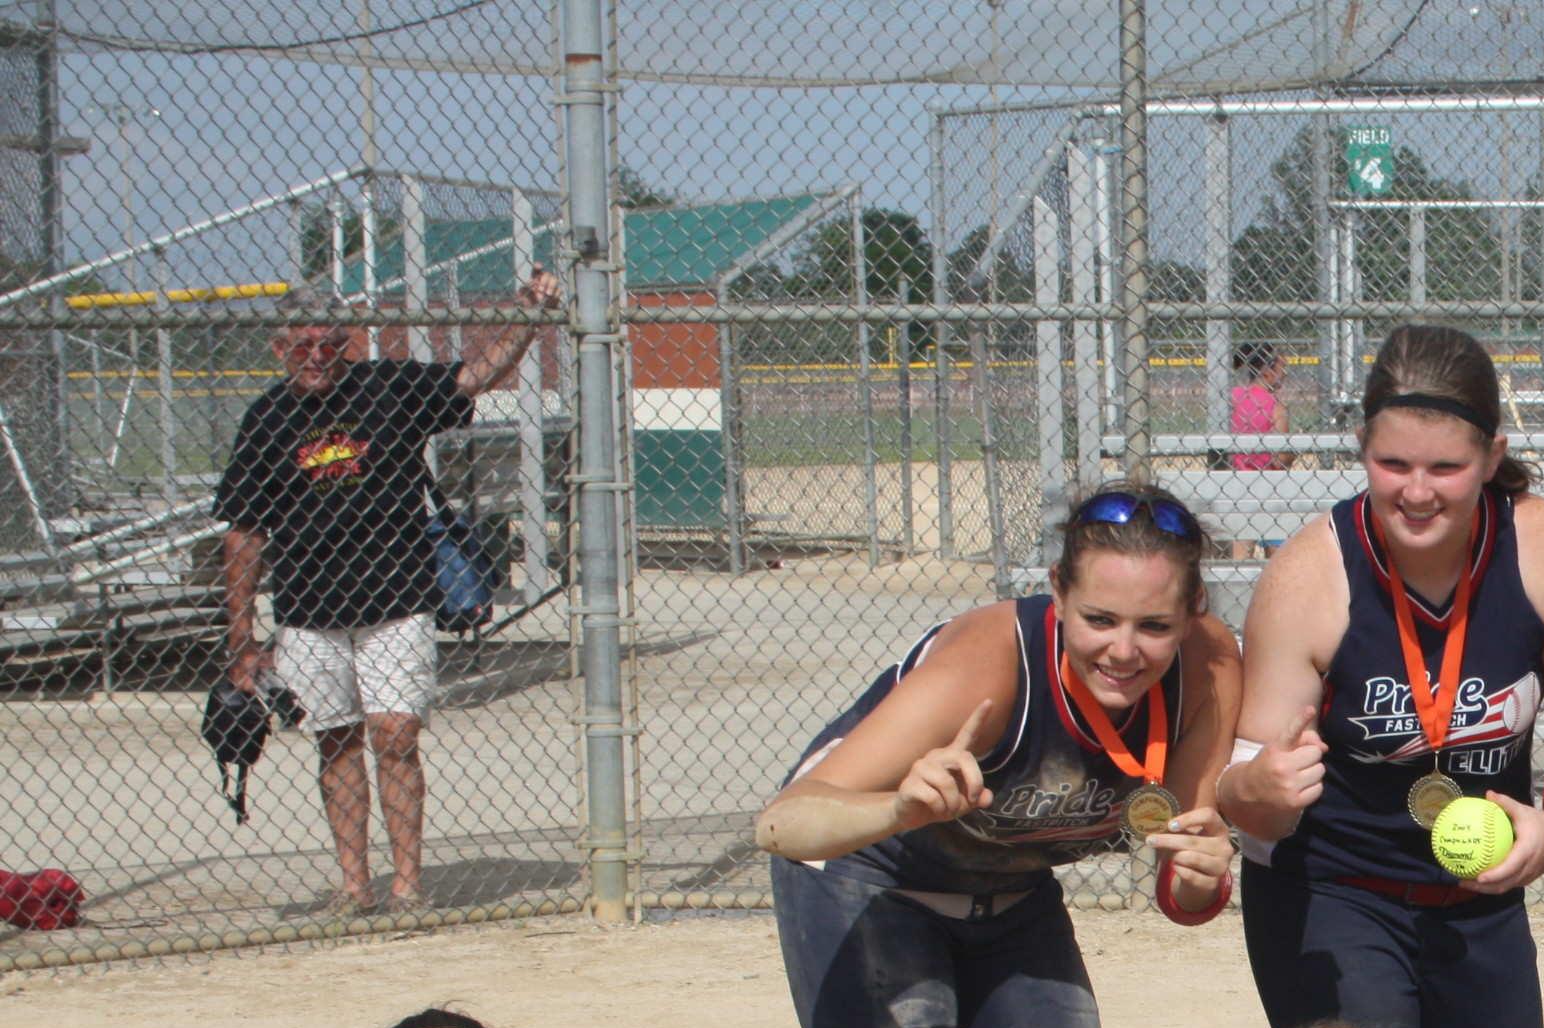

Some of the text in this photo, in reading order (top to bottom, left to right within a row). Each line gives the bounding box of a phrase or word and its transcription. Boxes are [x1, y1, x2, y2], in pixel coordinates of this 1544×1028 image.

[1349, 128, 1390, 144] FIELD
[1360, 157, 1385, 189] 4
[1363, 670, 1488, 716] Pre
[1000, 778, 1117, 818] Pride
